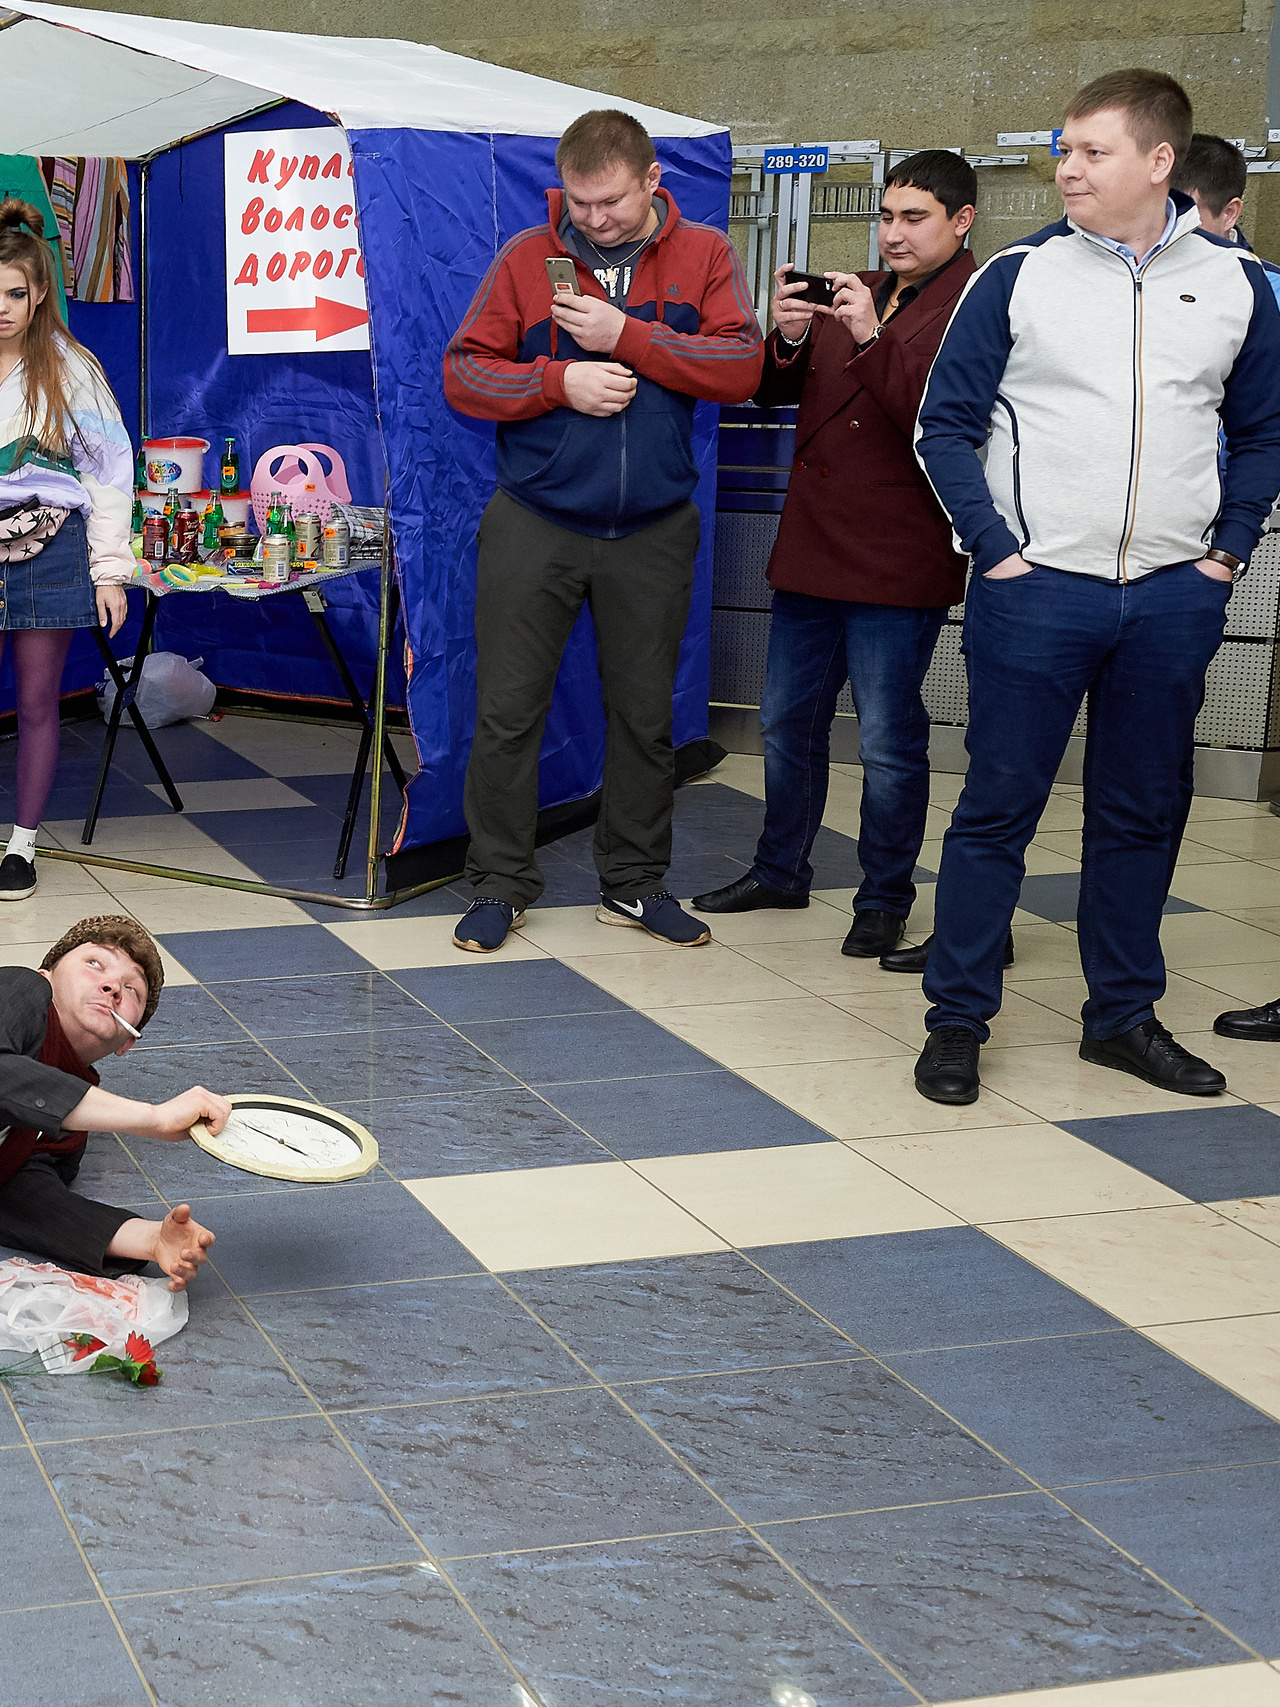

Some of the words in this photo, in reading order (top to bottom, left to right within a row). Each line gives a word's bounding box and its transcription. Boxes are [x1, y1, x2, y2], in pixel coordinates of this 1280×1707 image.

[247, 148, 354, 191] Купл
[766, 153, 826, 169] 289-320
[240, 196, 360, 235] волос
